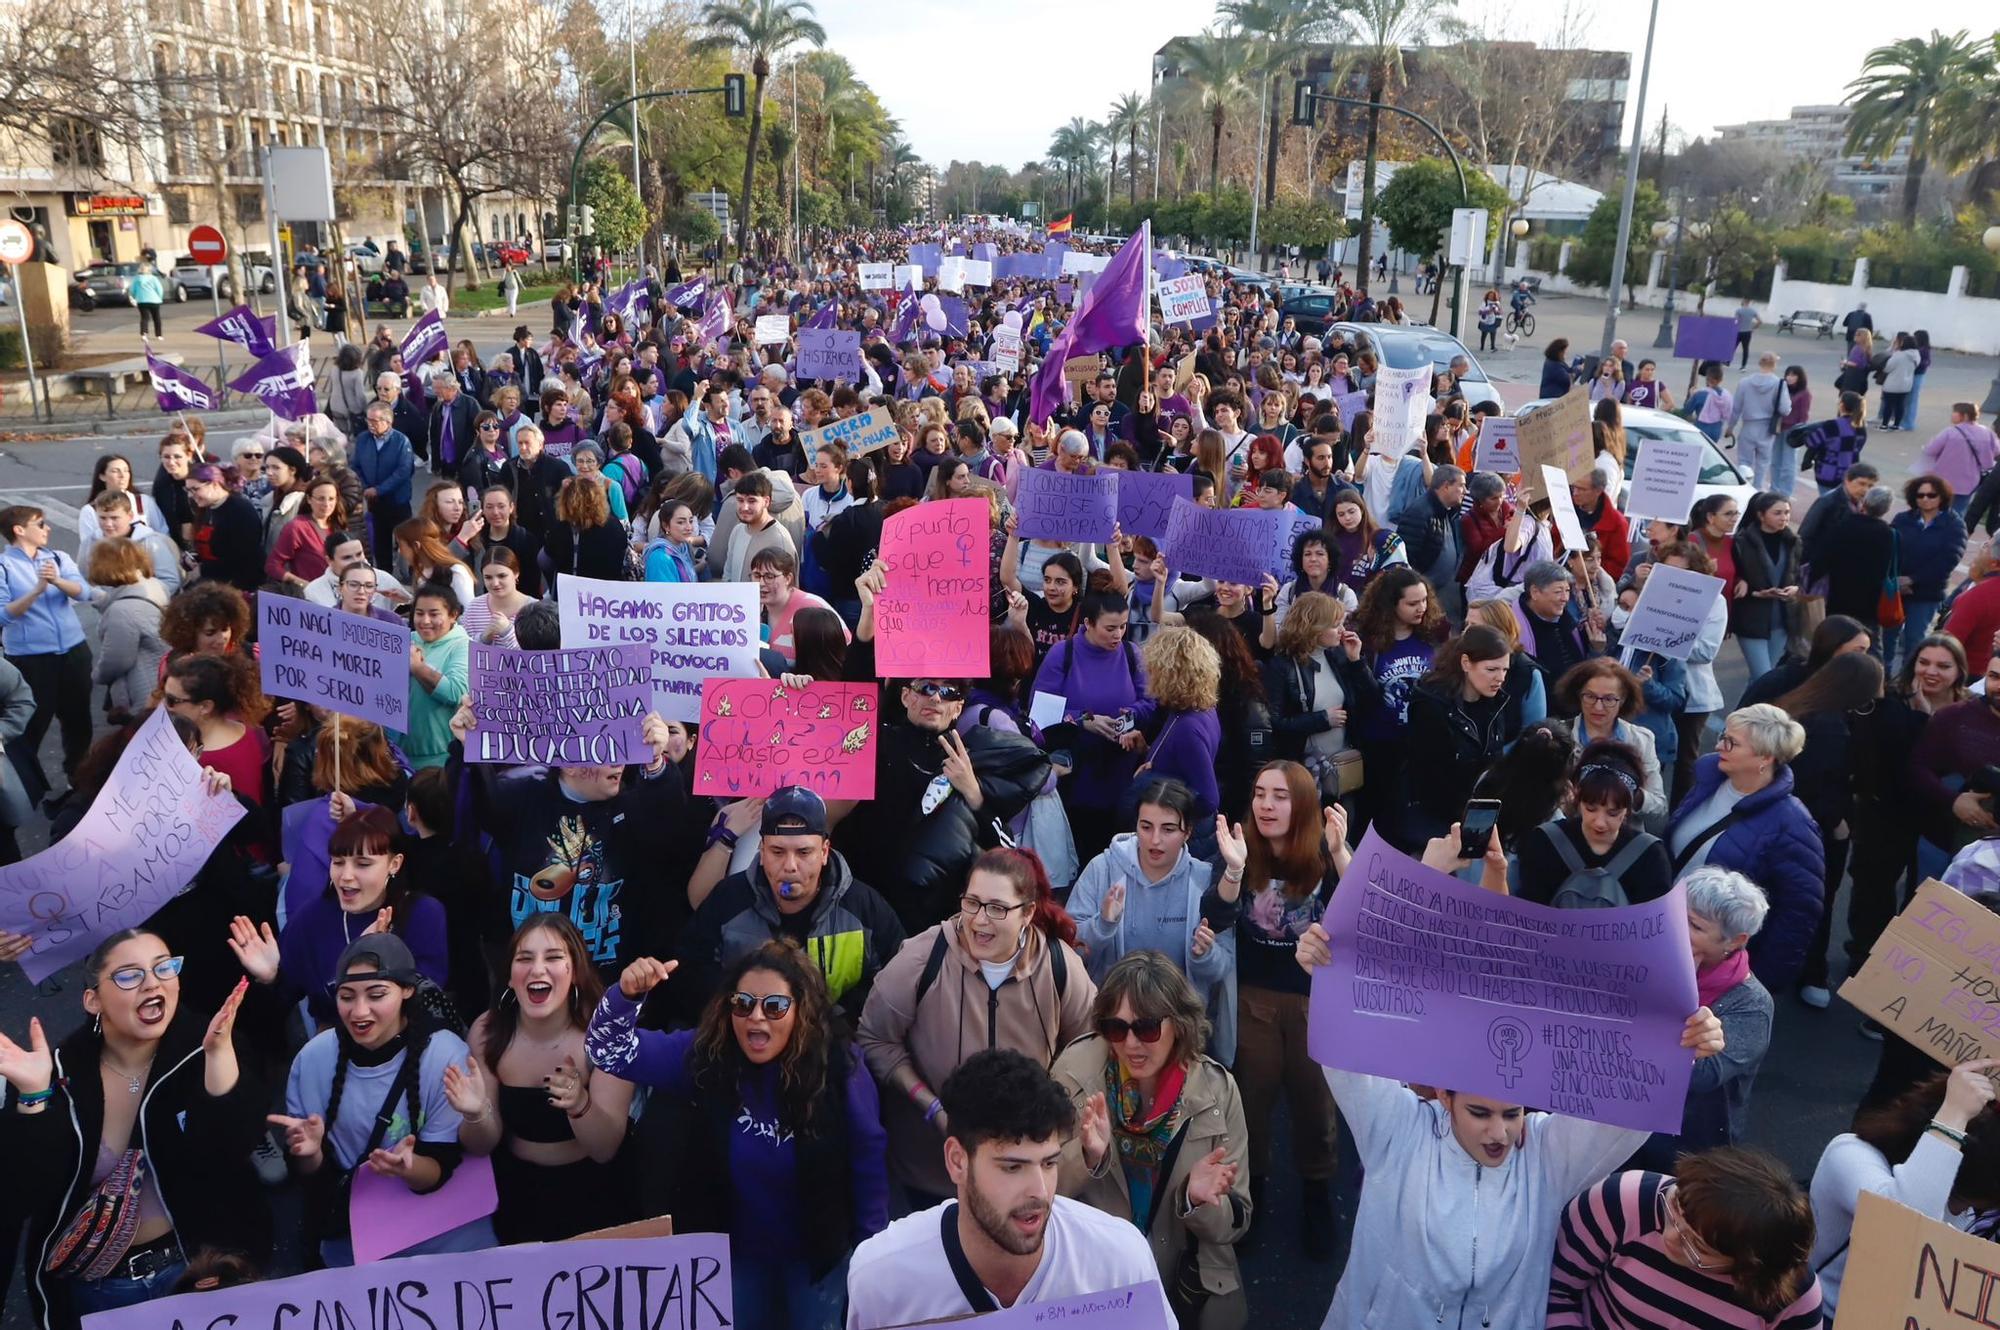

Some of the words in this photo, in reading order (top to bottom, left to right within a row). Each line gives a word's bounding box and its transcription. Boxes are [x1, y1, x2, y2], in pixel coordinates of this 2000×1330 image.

[1161, 286, 1172, 296] EL
[1039, 496, 1064, 514] NO
[1070, 497, 1094, 514] SE
[884, 517, 904, 545] El
[910, 502, 970, 544] punto
[1022, 517, 1098, 537] COMPRA
[1193, 512, 1211, 536] UN
[1216, 513, 1270, 541] SISTEMA
[903, 550, 944, 582] que
[928, 576, 984, 597] hemos
[1668, 582, 1702, 595] FEMINISMO
[578, 590, 663, 620] HAGAMOS
[672, 602, 746, 623] GRITOS
[268, 606, 291, 626] NO
[300, 611, 331, 636] NACÍ
[342, 621, 402, 654] MUJER
[588, 624, 610, 641] DE
[620, 626, 658, 643] LOS
[665, 627, 748, 647] SILENCIOS
[879, 616, 904, 639] que
[1631, 633, 1662, 648] para
[1656, 627, 1675, 636] SOCIAL
[281, 636, 322, 662] PARA
[333, 651, 382, 679] MORIR
[477, 651, 493, 671] EL
[499, 648, 622, 674] MACHISMO
[650, 651, 729, 671] PROVOCA
[275, 664, 307, 689] POR
[317, 675, 364, 705] SERLO
[376, 694, 402, 715] #8M
[481, 675, 497, 688] ES
[501, 677, 527, 691] UNA
[534, 667, 651, 692] ENFERMEDAD
[471, 690, 487, 706] DE
[476, 707, 533, 723] SOCIAL
[536, 708, 545, 721] Y
[550, 708, 569, 723] SU
[571, 697, 648, 723] VACUNA
[707, 680, 790, 718] Con
[797, 683, 877, 724] este
[555, 724, 577, 736] LA
[480, 724, 628, 764] EDUCACIÓN
[105, 786, 140, 832] ME
[131, 752, 195, 848] PORQUE
[1368, 852, 1424, 905] CALLAROS
[1429, 890, 1443, 914] YA
[1446, 896, 1482, 920] PUTOS
[1484, 907, 1557, 935] MACHISTAS
[1561, 923, 1577, 938] DE
[1581, 919, 1637, 942] MIERDA
[1641, 913, 1665, 940] QUE
[1361, 888, 1377, 911] ME
[1429, 917, 1469, 939] HASTA
[1476, 926, 1492, 944] EL
[1410, 930, 1438, 950] TAN
[1534, 951, 1566, 971] POR
[1572, 959, 1648, 984] VUESTRO
[1479, 960, 1503, 976] QUE
[1883, 946, 1928, 984] NO
[1356, 955, 1386, 981] DAIS
[1391, 964, 1417, 989] QUE
[1422, 968, 1455, 993] ESTO
[1458, 973, 1478, 997] LO
[1544, 985, 1638, 1018] PROVOCADO
[1881, 996, 1907, 1021] A
[1591, 1076, 1618, 1099] QUE
[1618, 1080, 1650, 1103] UNA
[1550, 1094, 1595, 1116] LUCHA
[542, 1256, 732, 1330] GRITAR
